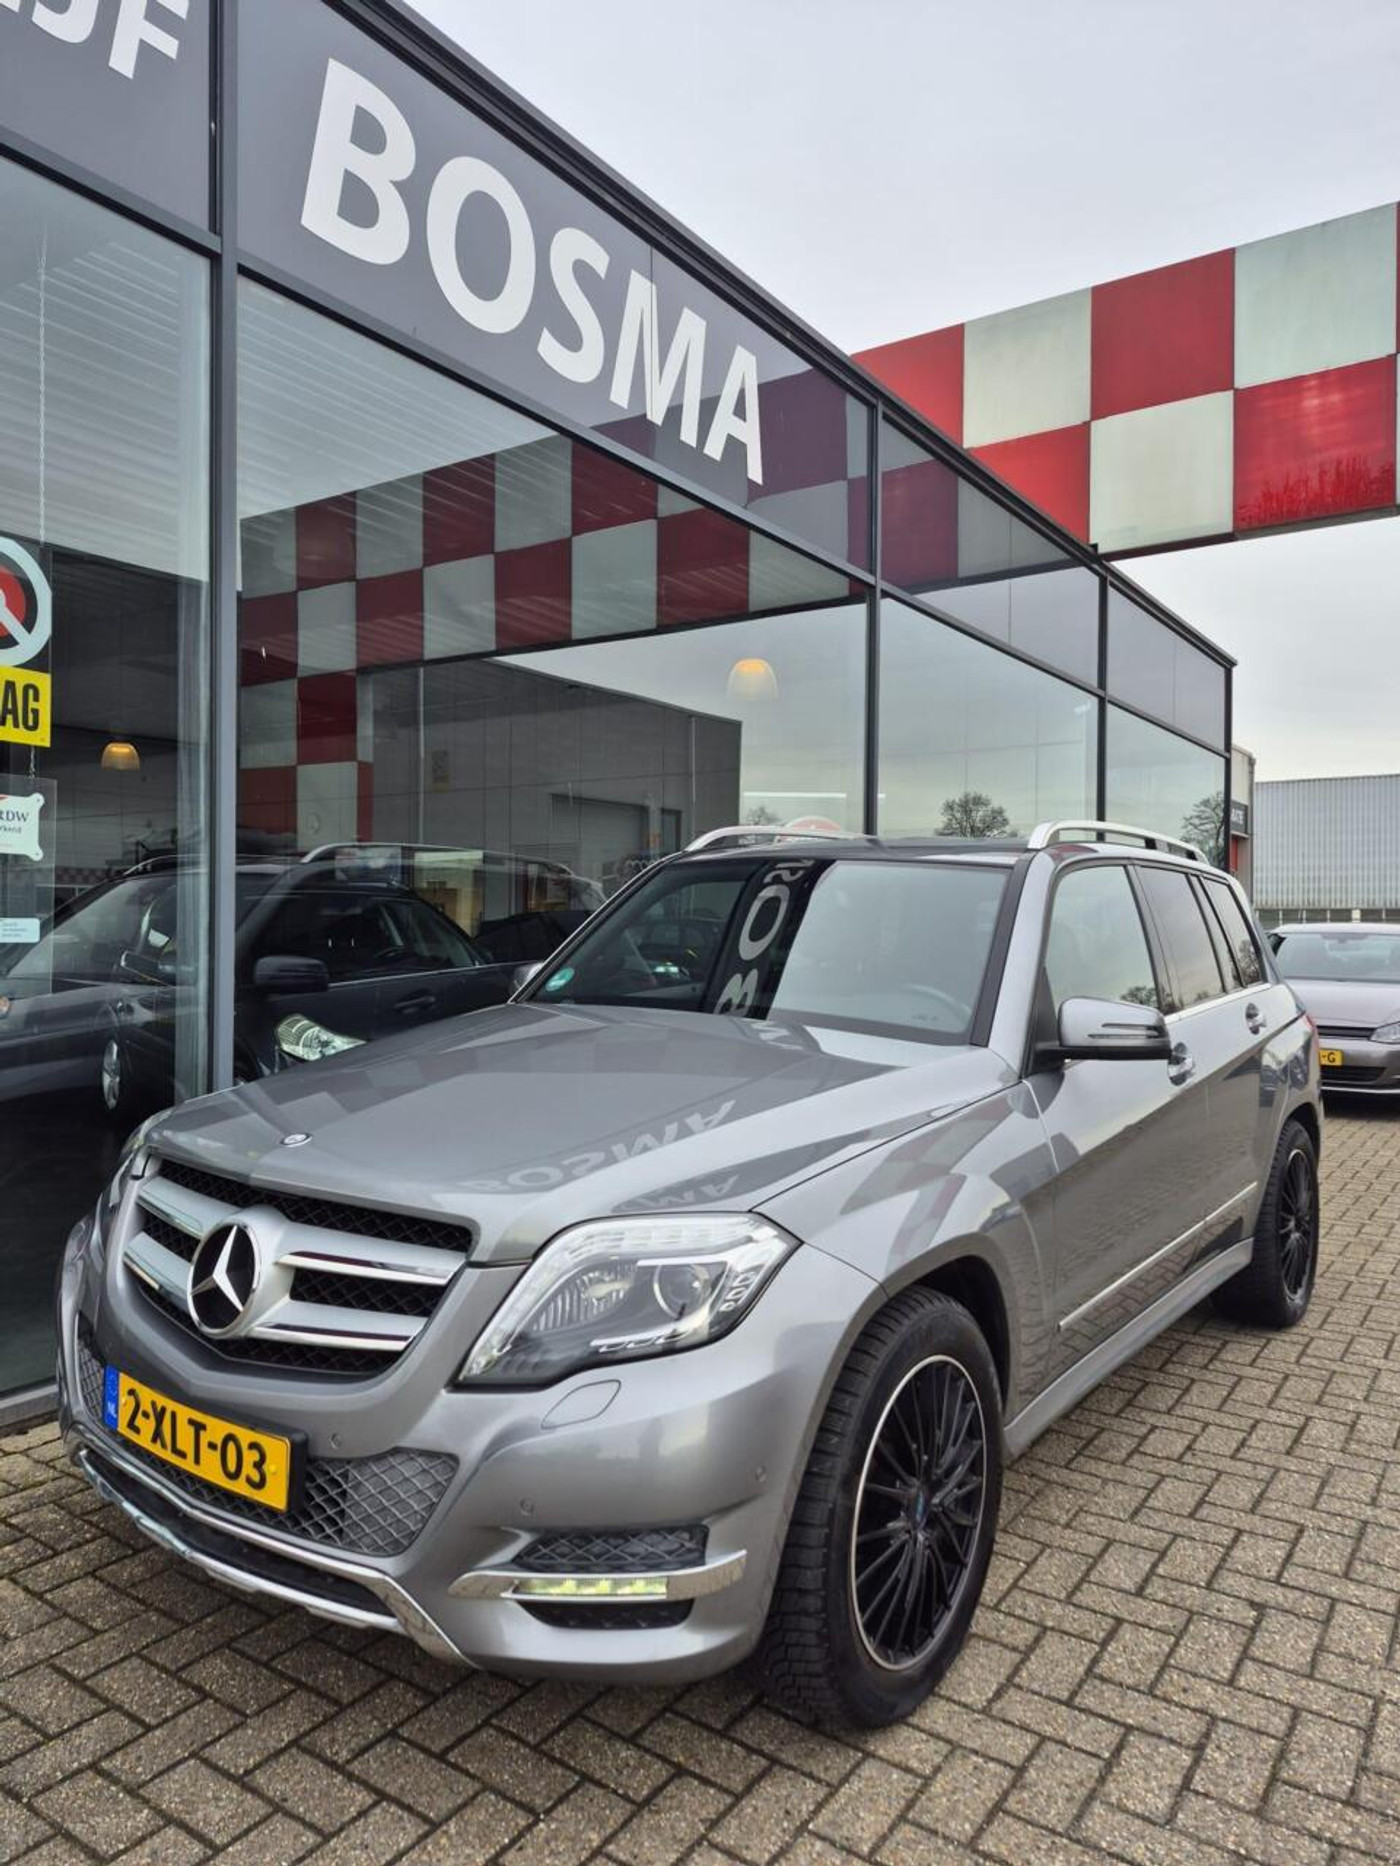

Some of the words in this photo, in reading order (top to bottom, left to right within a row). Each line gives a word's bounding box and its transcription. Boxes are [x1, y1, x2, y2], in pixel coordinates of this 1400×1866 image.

[300, 57, 764, 486] BOSMA
[0, 679, 40, 732] AG
[125, 1387, 268, 1491] 2-XLT-03
